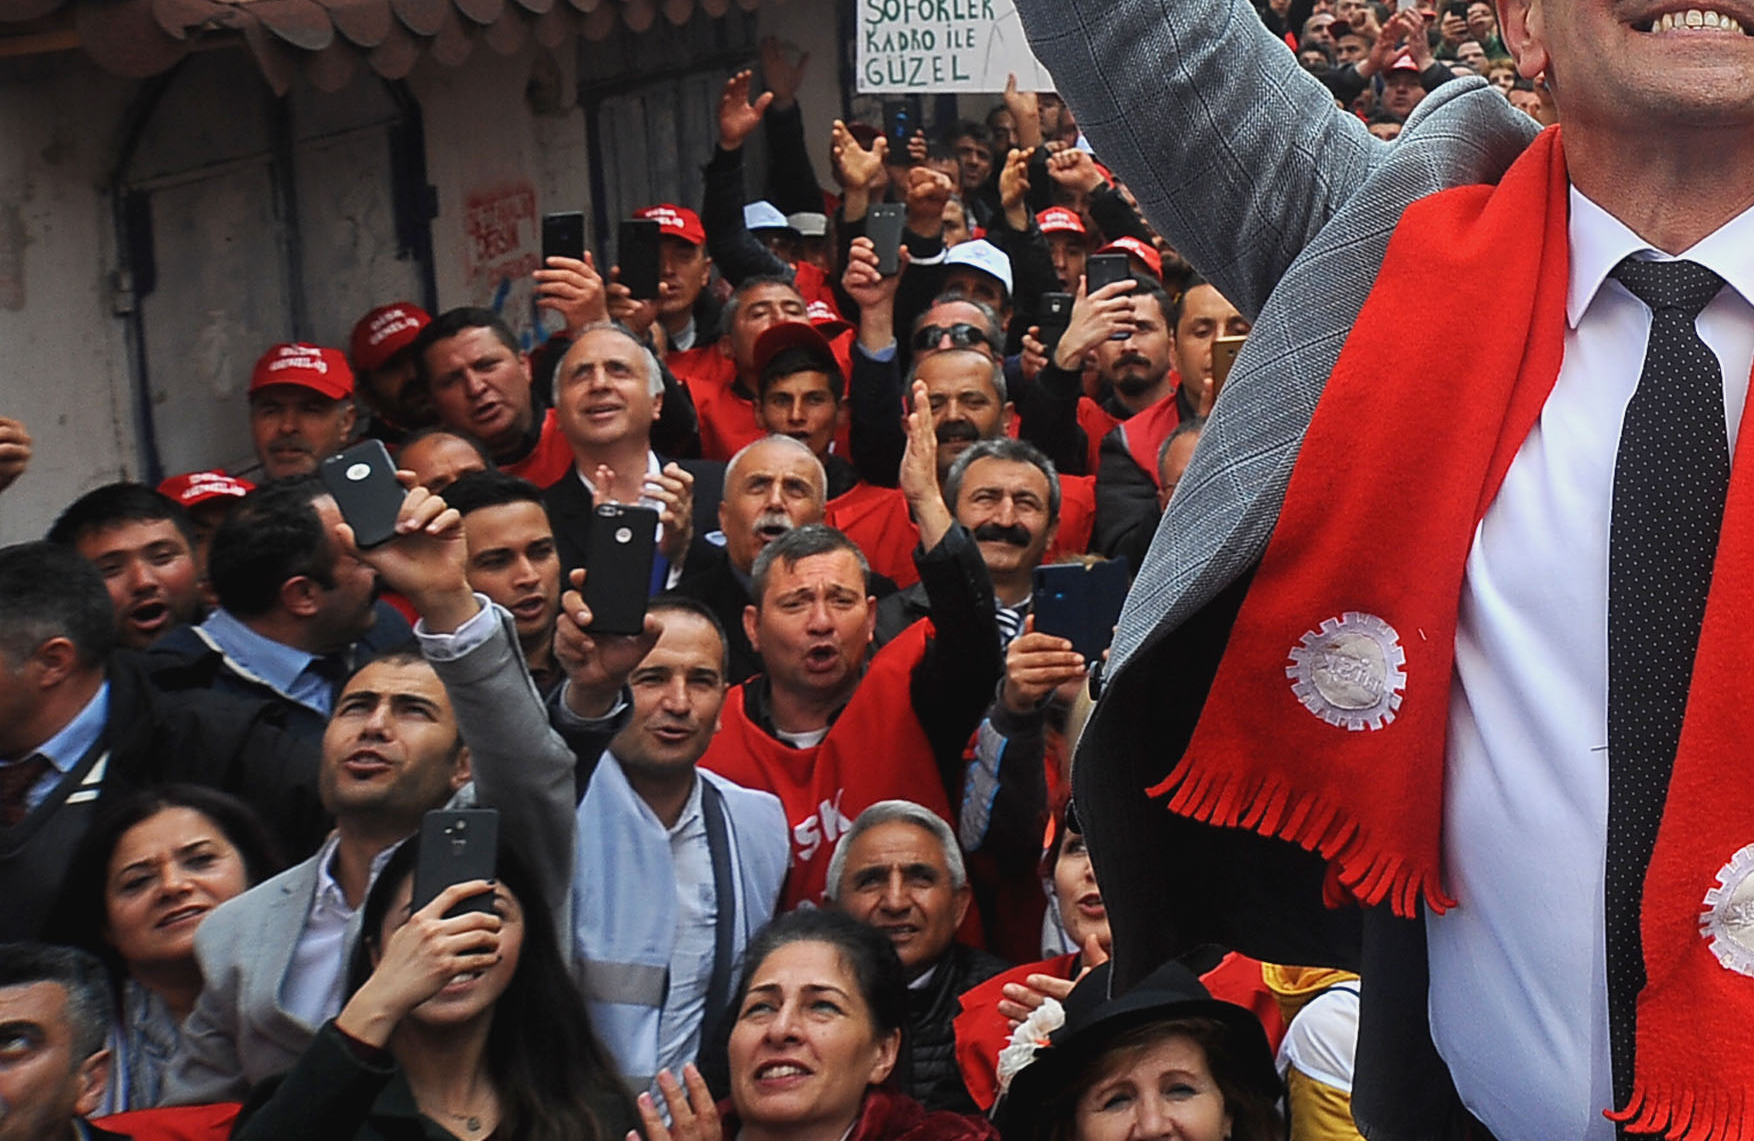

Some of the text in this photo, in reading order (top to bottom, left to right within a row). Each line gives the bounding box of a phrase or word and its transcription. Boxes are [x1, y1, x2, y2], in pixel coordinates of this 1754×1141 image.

[866, 23, 975, 53] KADRO İLE
[865, 55, 970, 86] GÜZEL
